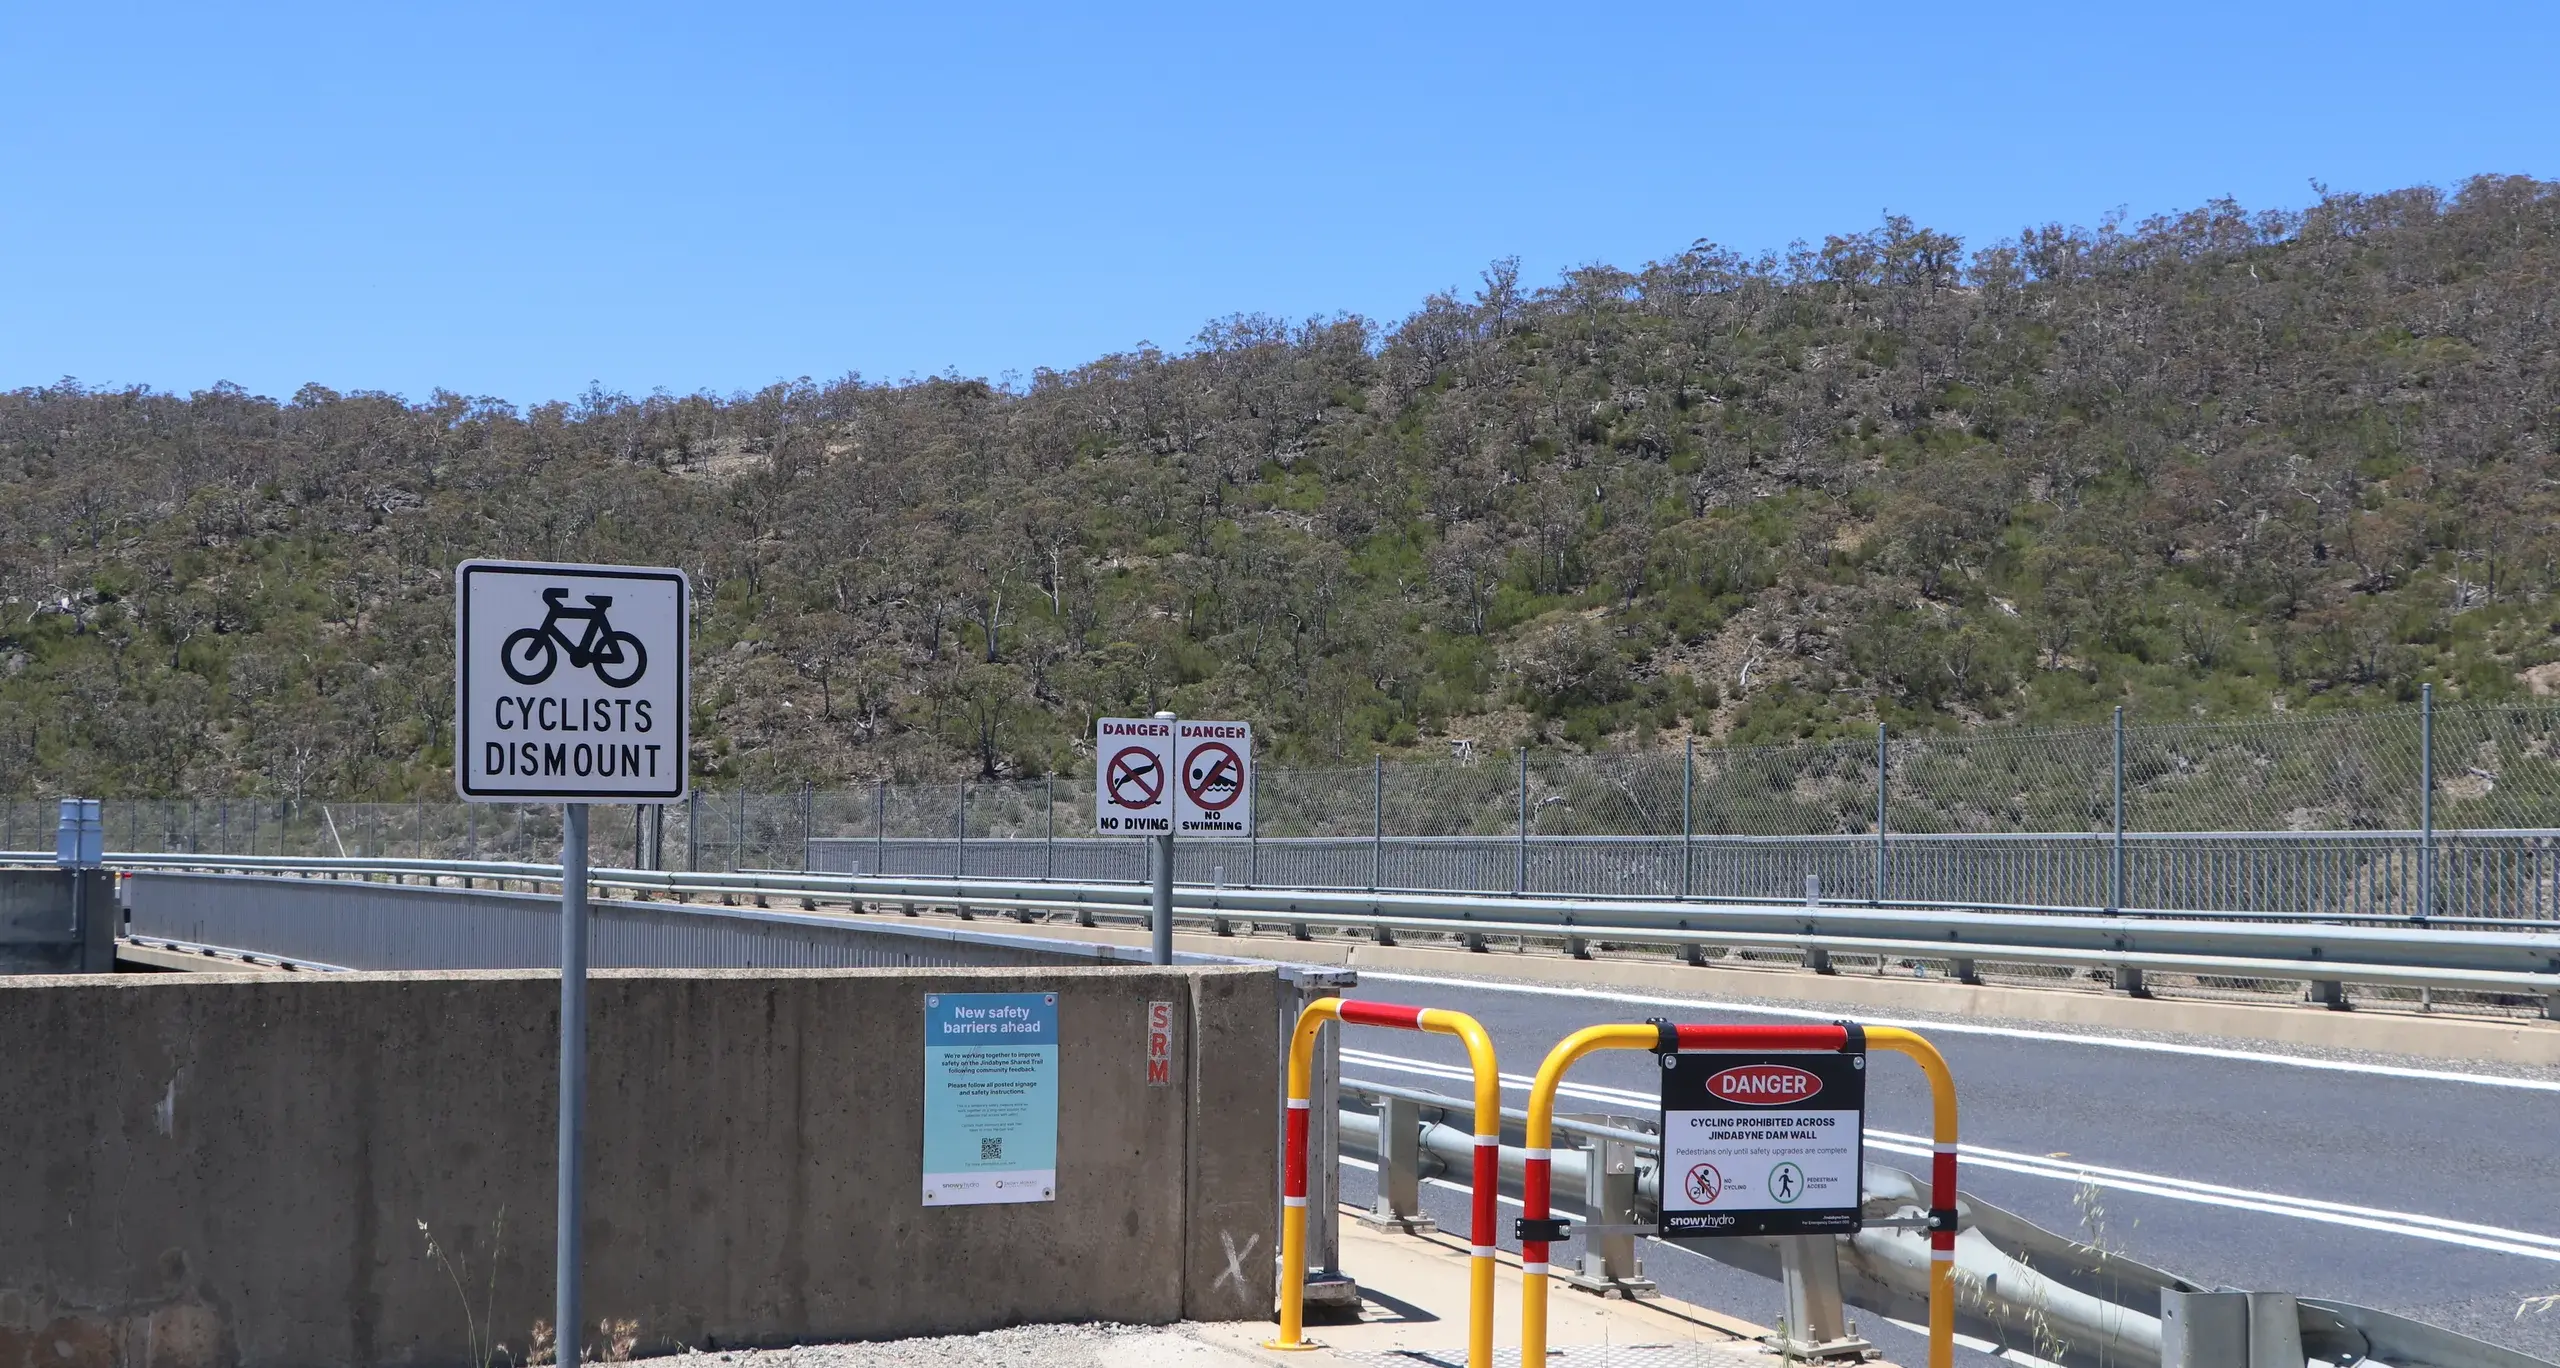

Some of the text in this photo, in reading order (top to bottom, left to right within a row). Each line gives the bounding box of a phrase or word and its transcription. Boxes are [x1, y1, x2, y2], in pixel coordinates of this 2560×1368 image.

[495, 695, 652, 733] CYCLISTS
[1103, 723, 1170, 737] DANGER
[1181, 726, 1246, 739] DANGER
[486, 741, 661, 778] DISMOUNT
[1204, 811, 1221, 820] NO
[1100, 817, 1169, 831] NO DIVING
[1182, 821, 1242, 831] SWIMMING
[955, 1005, 1030, 1021] New safety
[943, 1020, 1041, 1034] barriers ahead
[962, 1052, 985, 1060] working
[986, 1052, 1010, 1060] together
[980, 1059, 1010, 1067] Jindabyne
[1722, 1074, 1807, 1094] DANGER
[1690, 1118, 1836, 1128] CYCLING PROHIBITED ACROSS
[1708, 1130, 1818, 1140] JINDABYNE DAM WALL
[1676, 1148, 1716, 1156] Pedestrians
[1718, 1148, 1732, 1157] only
[1734, 1148, 1748, 1156] until
[1750, 1148, 1770, 1156] safety
[1772, 1148, 1804, 1156] upgrades
[1816, 1147, 1848, 1156] complete
